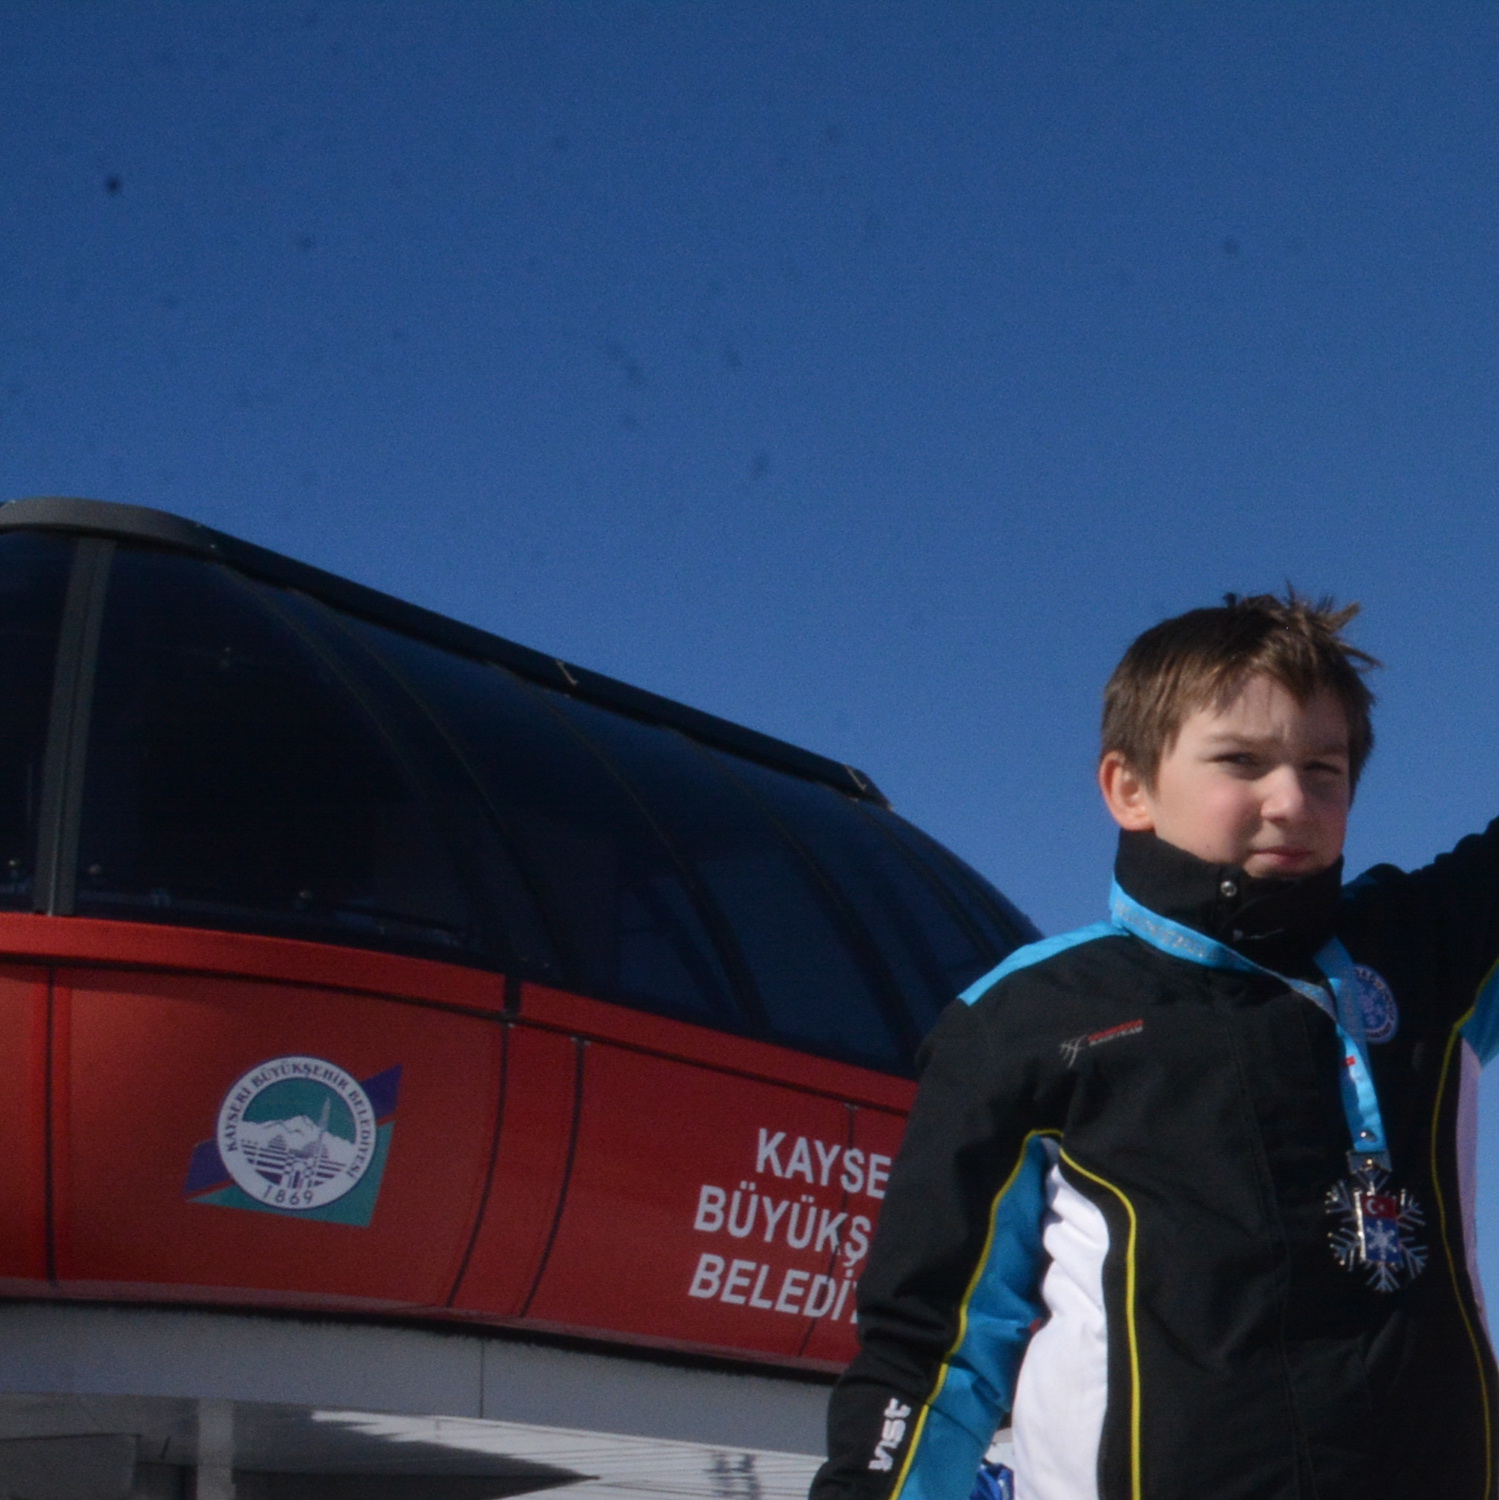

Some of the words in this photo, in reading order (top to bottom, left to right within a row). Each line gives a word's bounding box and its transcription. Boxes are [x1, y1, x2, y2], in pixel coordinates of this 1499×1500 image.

[263, 1184, 313, 1206] 1869
[756, 1128, 892, 1199] KAYSE
[694, 1180, 872, 1268] BÜYÜKŞ
[688, 1252, 858, 1324] BELEDİ
